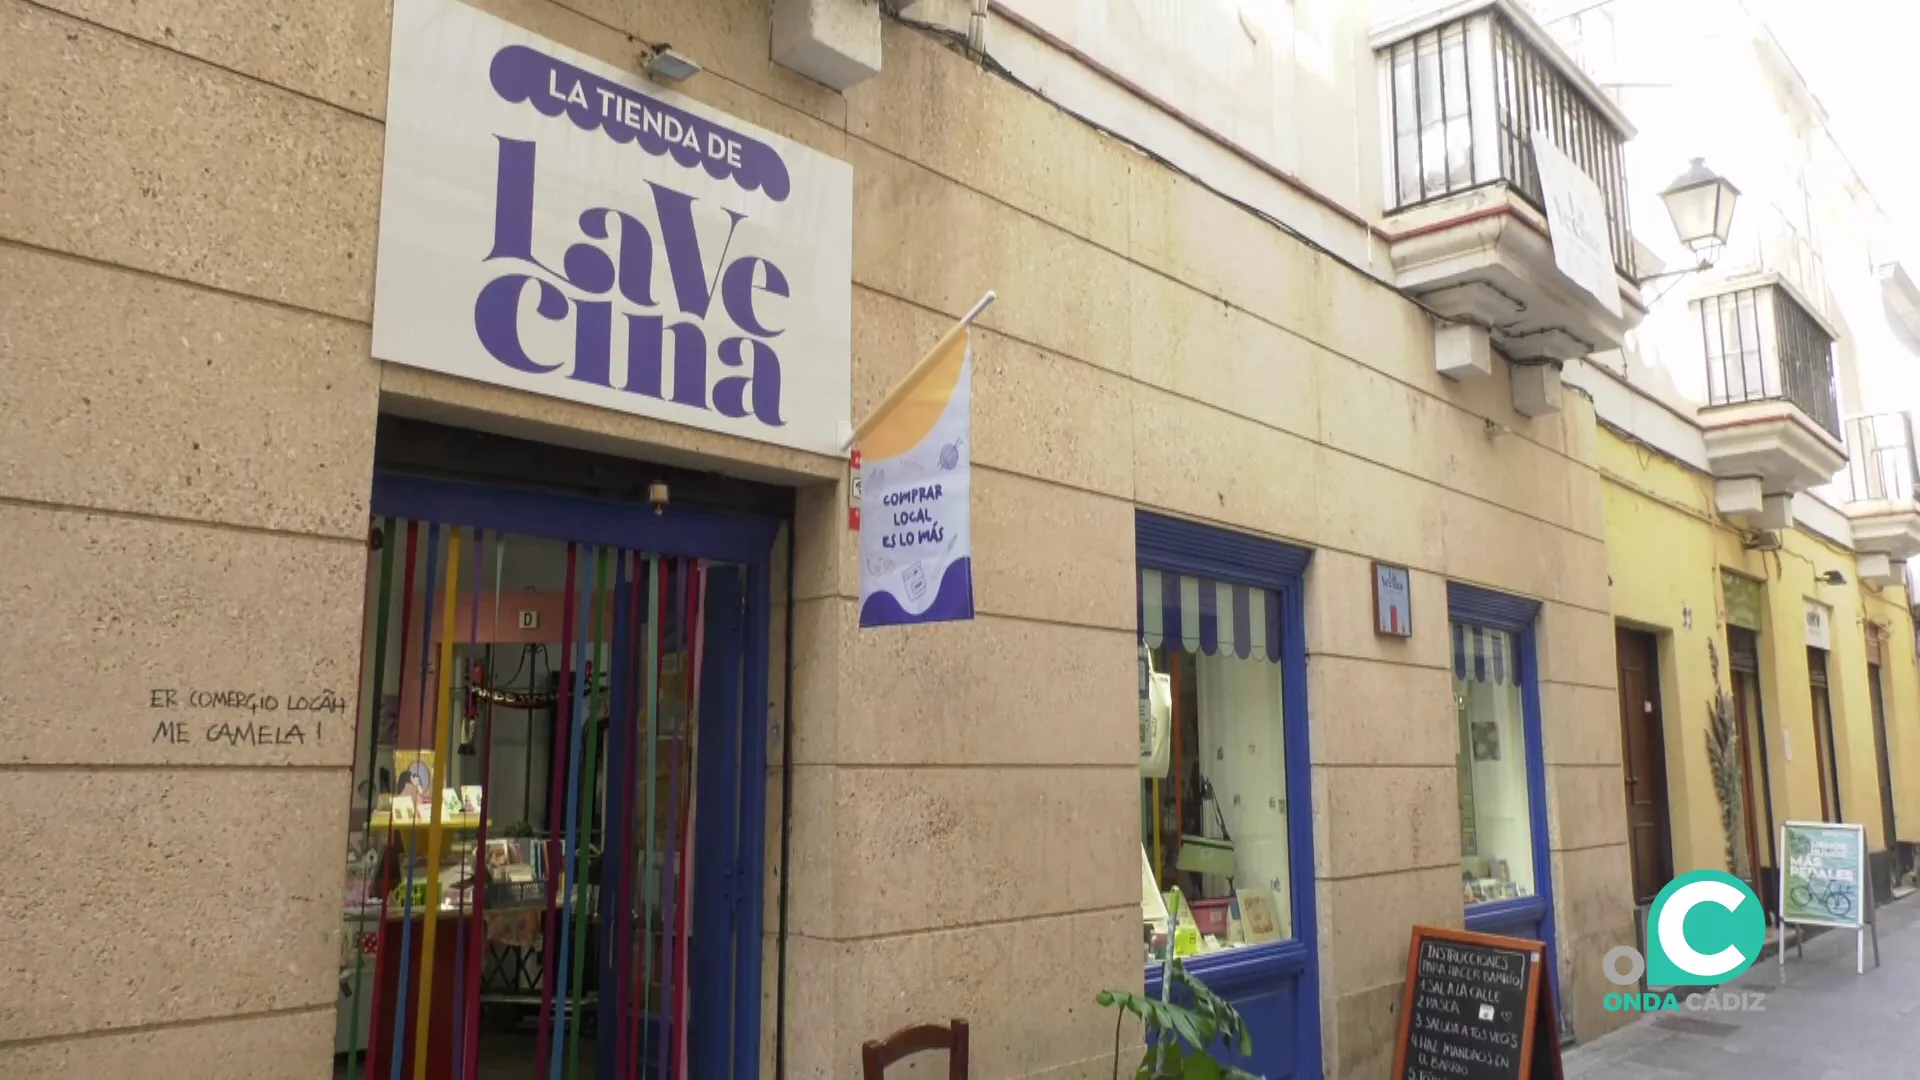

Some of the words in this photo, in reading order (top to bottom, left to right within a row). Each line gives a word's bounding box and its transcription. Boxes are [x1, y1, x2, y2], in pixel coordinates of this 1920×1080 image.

[549, 69, 588, 109] LA
[597, 87, 701, 152] TIENDA
[708, 131, 743, 168] DE
[883, 484, 943, 506] COMPRAR
[894, 508, 932, 526] LOCAL
[882, 534, 896, 548] ES
[900, 532, 915, 547] LO
[918, 521, 944, 544] MÁS
[523, 612, 533, 626] D
[150, 689, 177, 708] ER
[152, 721, 190, 744] ME
[1427, 944, 1508, 970] INSTRUCCIONES
[1422, 959, 1446, 975] PARA
[1483, 970, 1520, 986] BARRIO
[1427, 979, 1445, 995] SAL
[1447, 982, 1454, 995] A
[1456, 982, 1468, 999] LA
[1469, 986, 1500, 1003] CALLE
[1461, 1025, 1468, 1039] A
